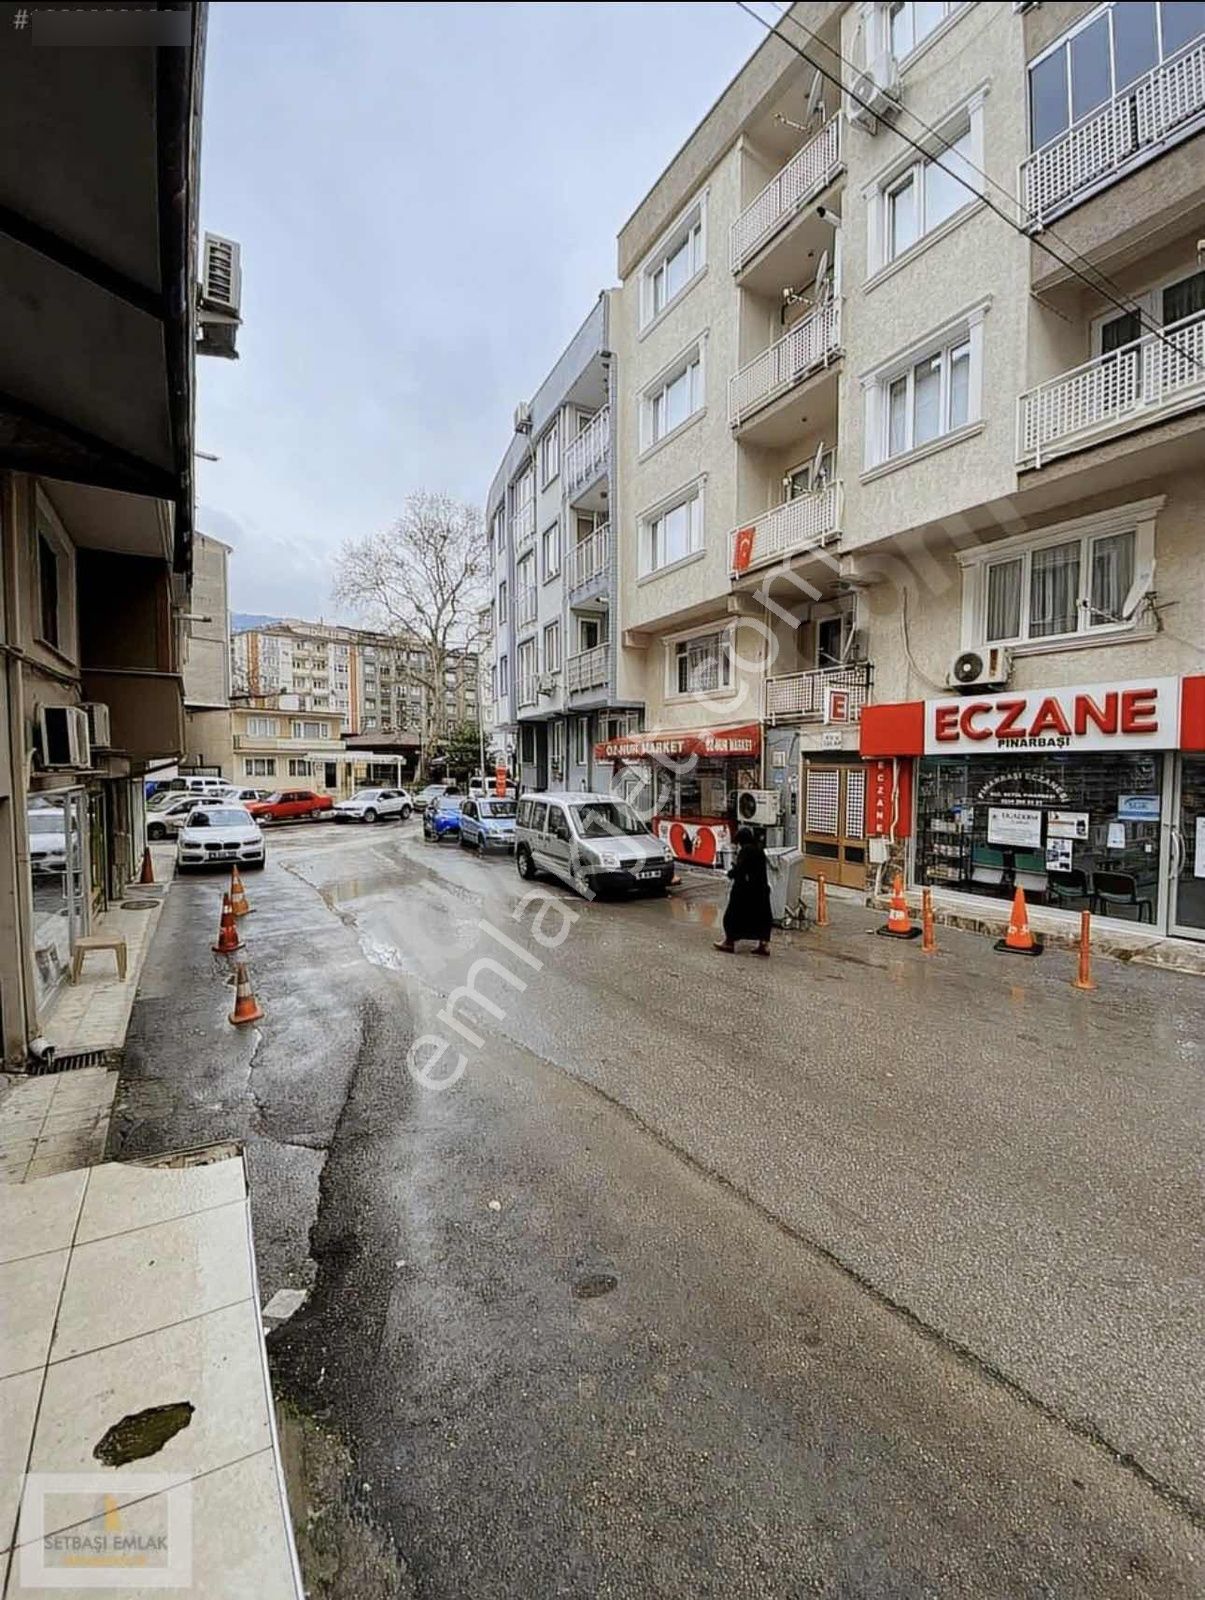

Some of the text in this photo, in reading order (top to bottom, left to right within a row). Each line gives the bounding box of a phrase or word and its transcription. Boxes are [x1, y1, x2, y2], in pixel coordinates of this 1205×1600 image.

[832, 694, 846, 719] E
[935, 688, 1159, 742] ECZANE
[641, 740, 684, 755] MARKET
[998, 737, 1071, 749] PINARBAŞI
[876, 761, 885, 832] ECZANE
